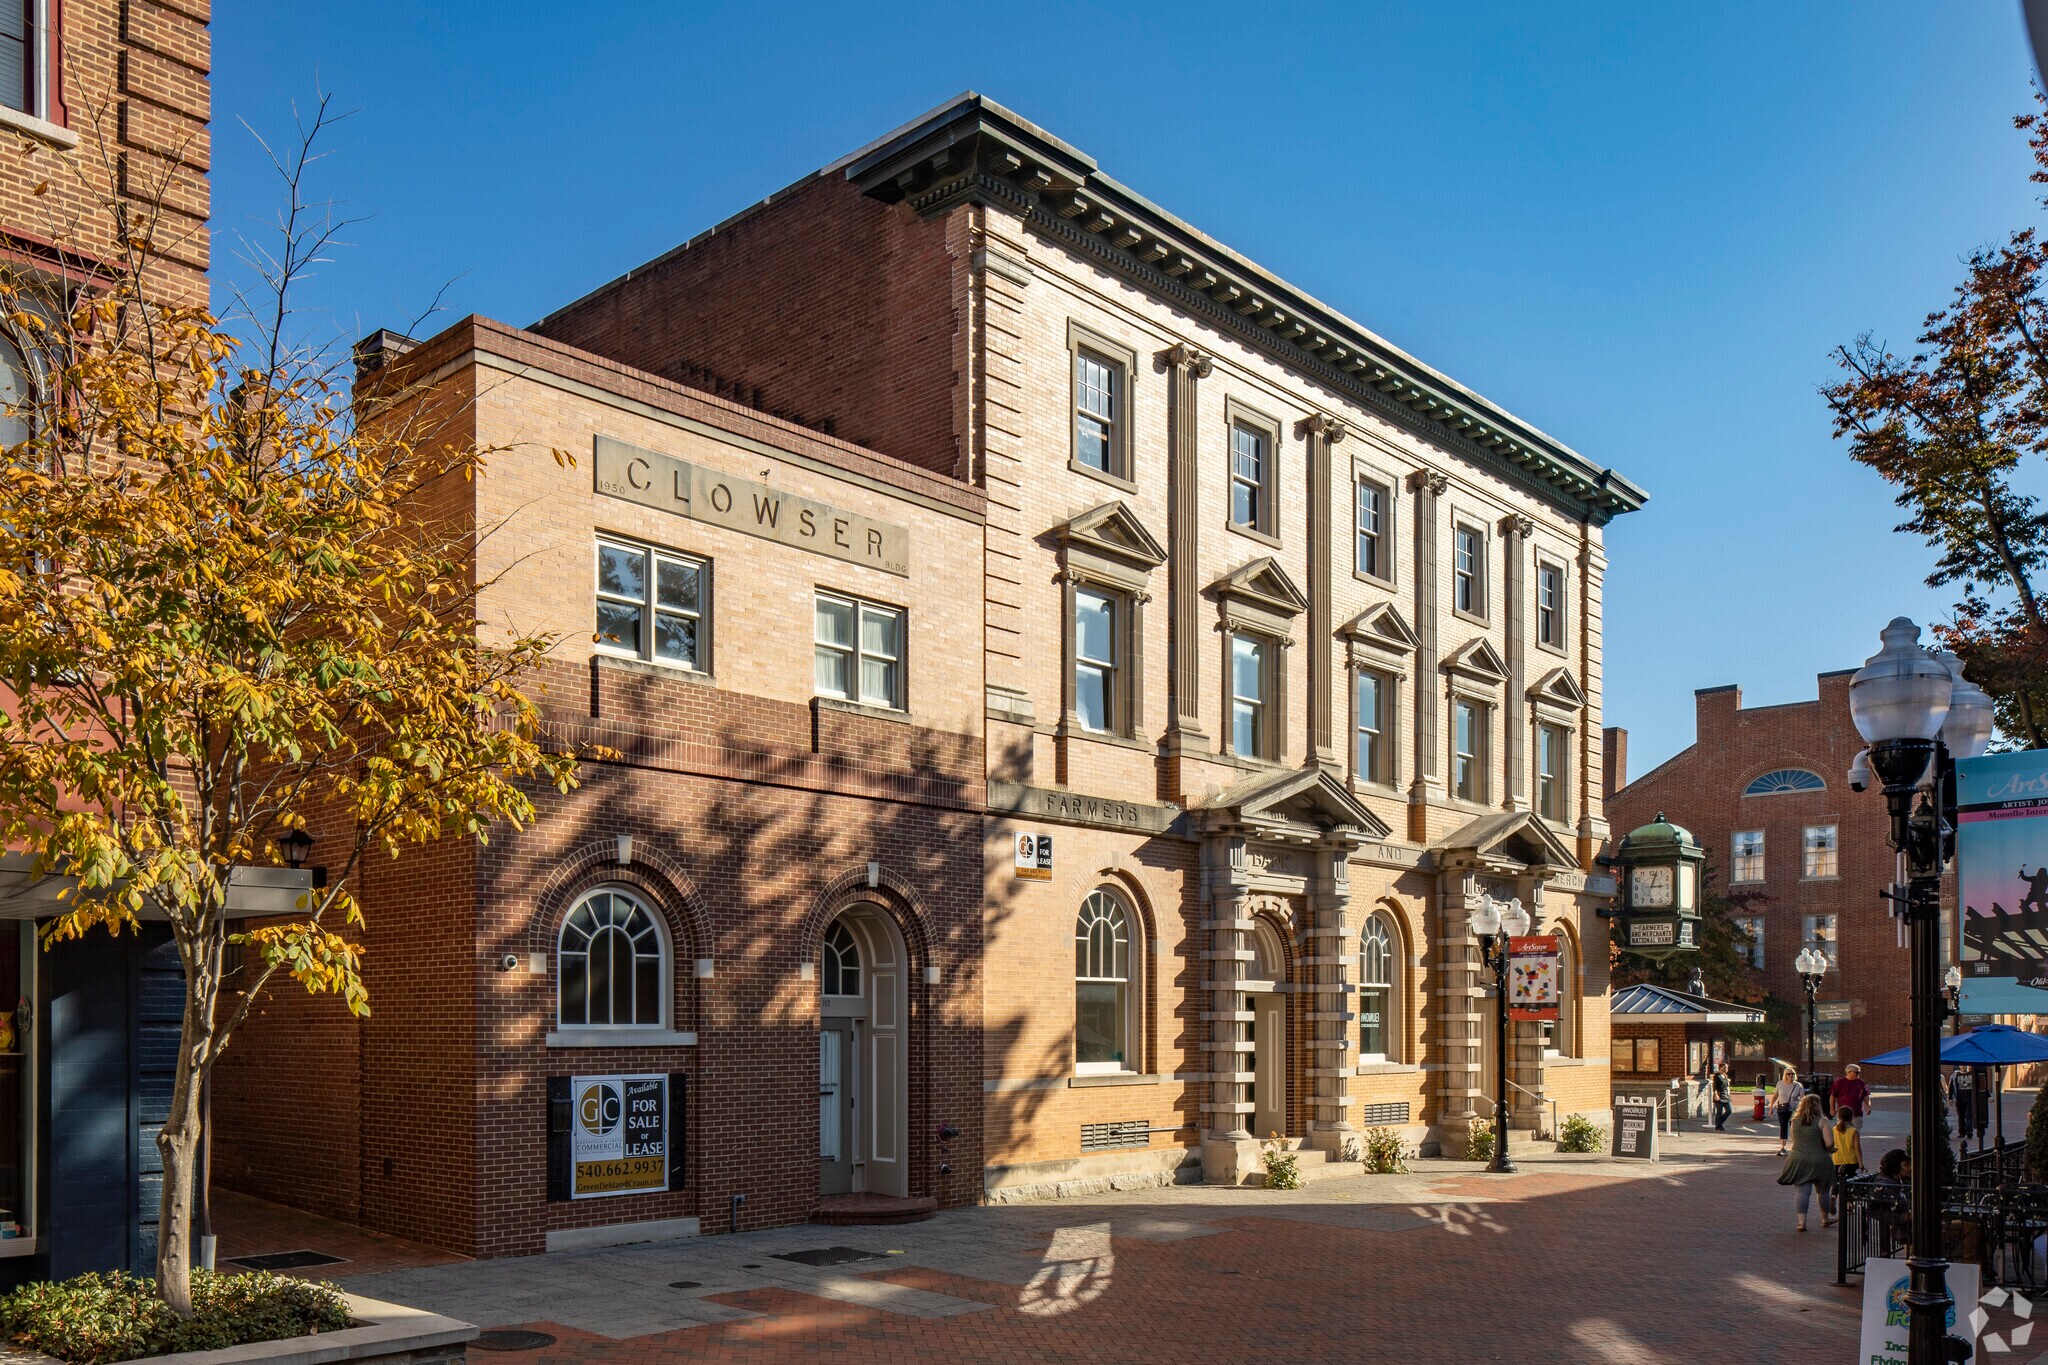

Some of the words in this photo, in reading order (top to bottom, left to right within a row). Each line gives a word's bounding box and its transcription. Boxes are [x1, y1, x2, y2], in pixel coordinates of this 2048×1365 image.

[600, 480, 625, 495] 1950
[627, 457, 883, 558] CLOWSER
[885, 560, 907, 573] BLDG
[1047, 794, 1137, 822] FARMERS
[2002, 800, 2034, 809] ARTIST:
[1988, 810, 2024, 819] Monoflo
[1039, 848, 1050, 856] FOR
[1252, 848, 1291, 870] BANK
[1378, 846, 1402, 860] AND
[1037, 857, 1052, 866] LEASE
[1552, 874, 1606, 889] MERCHNTS
[627, 1080, 659, 1097] Available
[632, 1099, 657, 1113] FOR
[628, 1115, 660, 1129] SALE
[640, 1132, 650, 1140] or
[577, 1143, 622, 1151] COMMERCIAL
[625, 1141, 663, 1156] LEASE
[577, 1160, 664, 1179] 540.662.9937
[577, 1179, 664, 1191] GreenfieldandCraun.com
